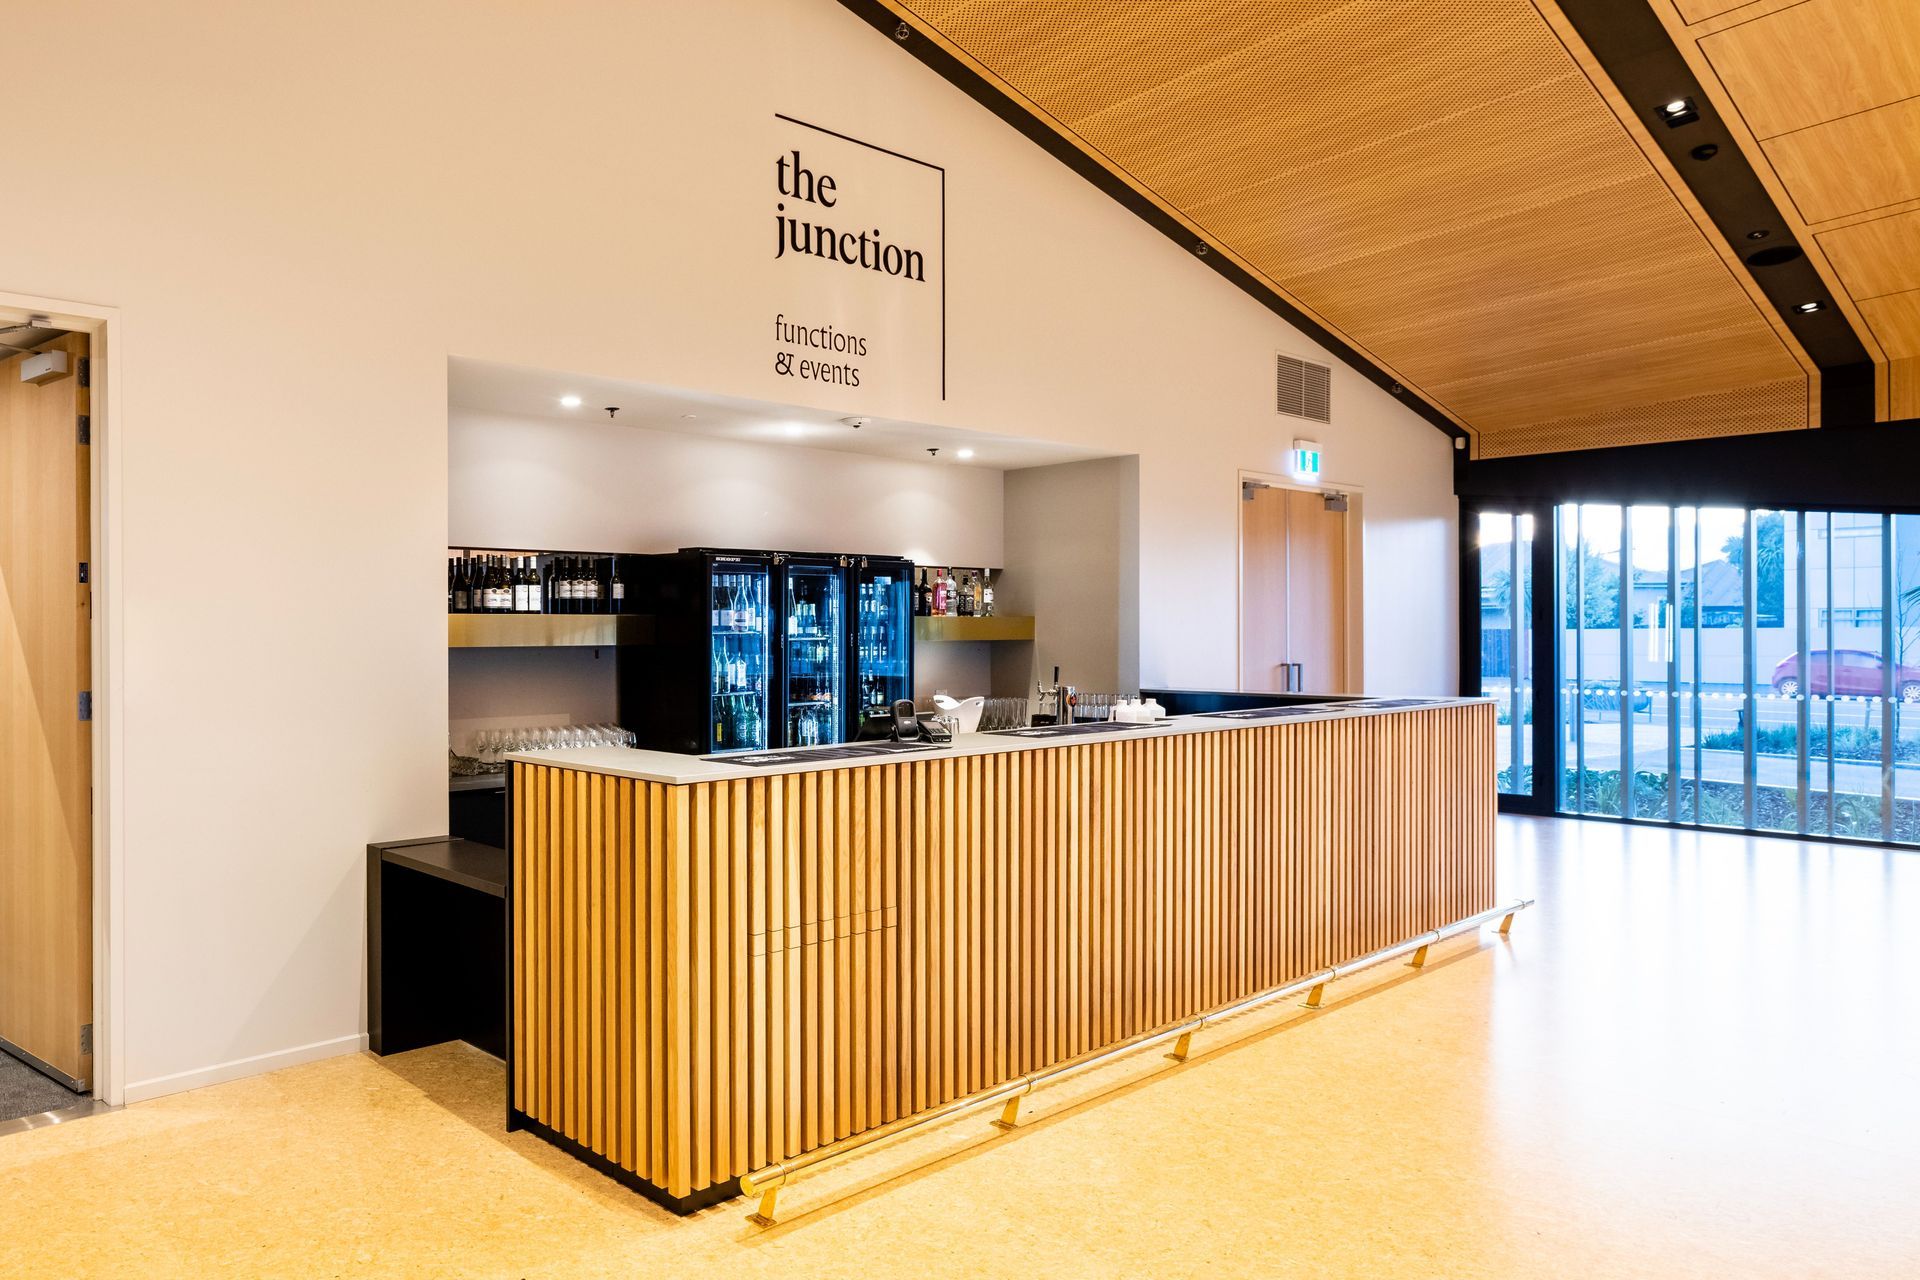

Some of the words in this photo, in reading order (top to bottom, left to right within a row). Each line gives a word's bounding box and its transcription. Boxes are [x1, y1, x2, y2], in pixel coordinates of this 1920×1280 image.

[776, 150, 837, 208] the
[775, 203, 926, 283] junction
[775, 314, 867, 357] functions
[775, 352, 794, 377] &
[800, 360, 860, 387] events
